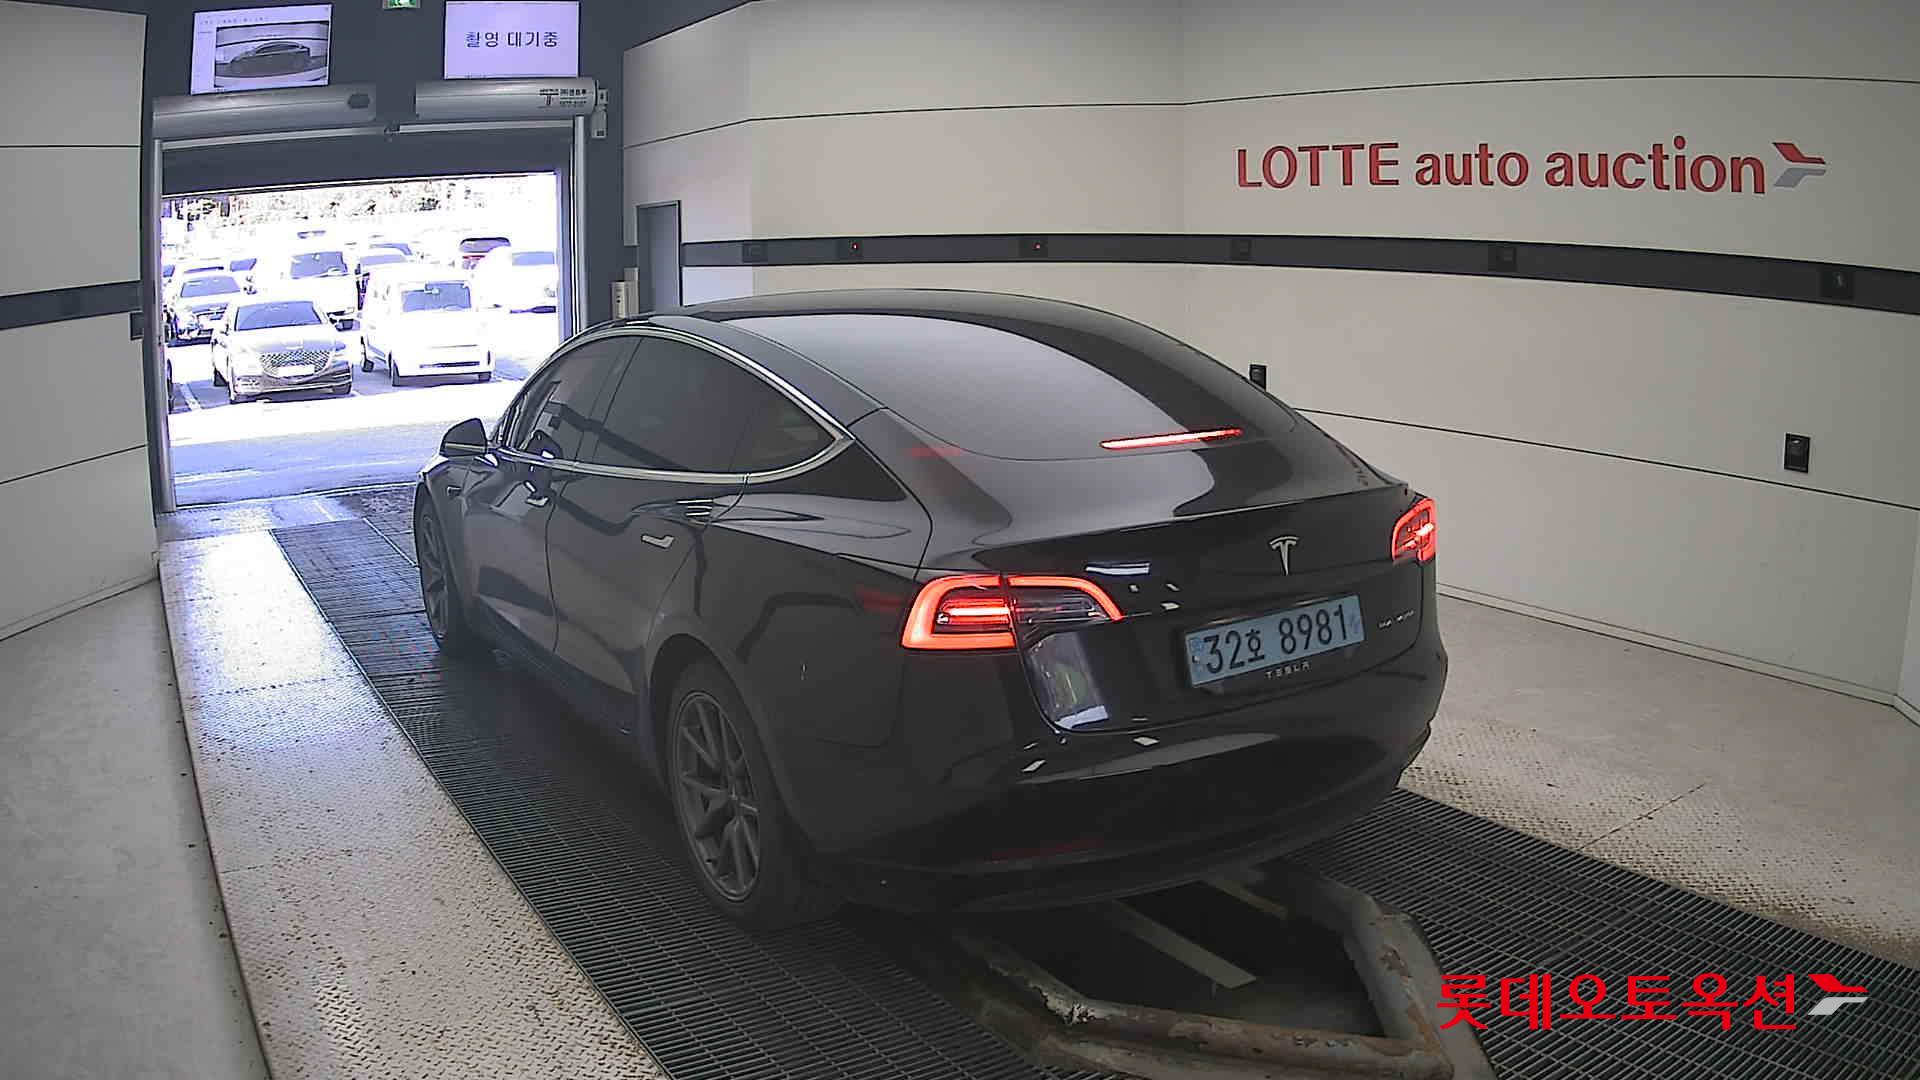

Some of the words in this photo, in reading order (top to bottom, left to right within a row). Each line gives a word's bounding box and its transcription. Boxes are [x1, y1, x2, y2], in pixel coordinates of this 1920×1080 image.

[507, 31, 558, 48] 대기중
[1237, 142, 1400, 188] LOTTE
[1415, 143, 1530, 187] auto
[1543, 135, 1767, 194] auction
[1203, 628, 1266, 674] 32호
[1278, 604, 1348, 654] 8981
[1265, 661, 1311, 679] TESLA
